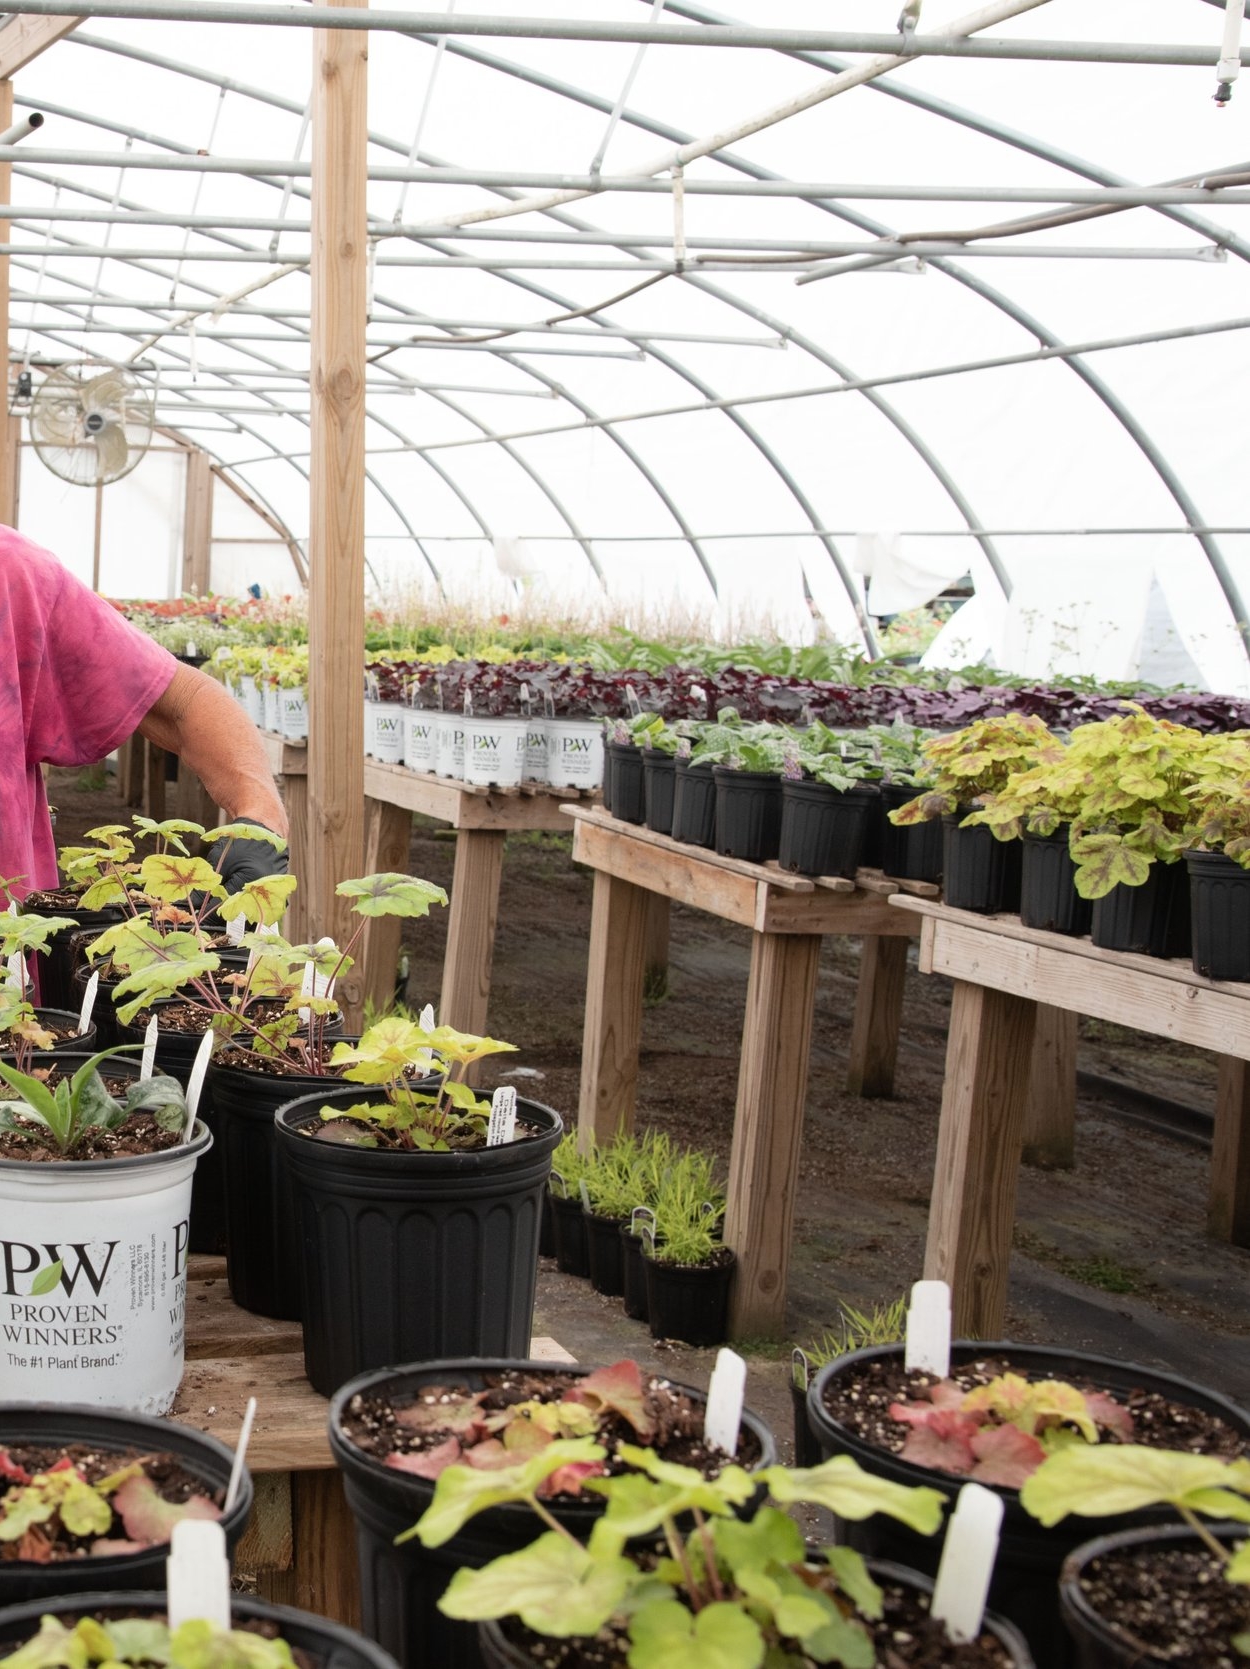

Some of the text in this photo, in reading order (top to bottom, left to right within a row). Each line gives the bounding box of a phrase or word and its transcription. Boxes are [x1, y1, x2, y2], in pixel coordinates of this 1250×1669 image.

[473, 734, 502, 750] PW
[563, 737, 593, 752] PW
[9, 1303, 108, 1324] PROVEN
[7, 1353, 27, 1368] The
[30, 1357, 44, 1369] #1
[48, 1357, 78, 1369] Plant
